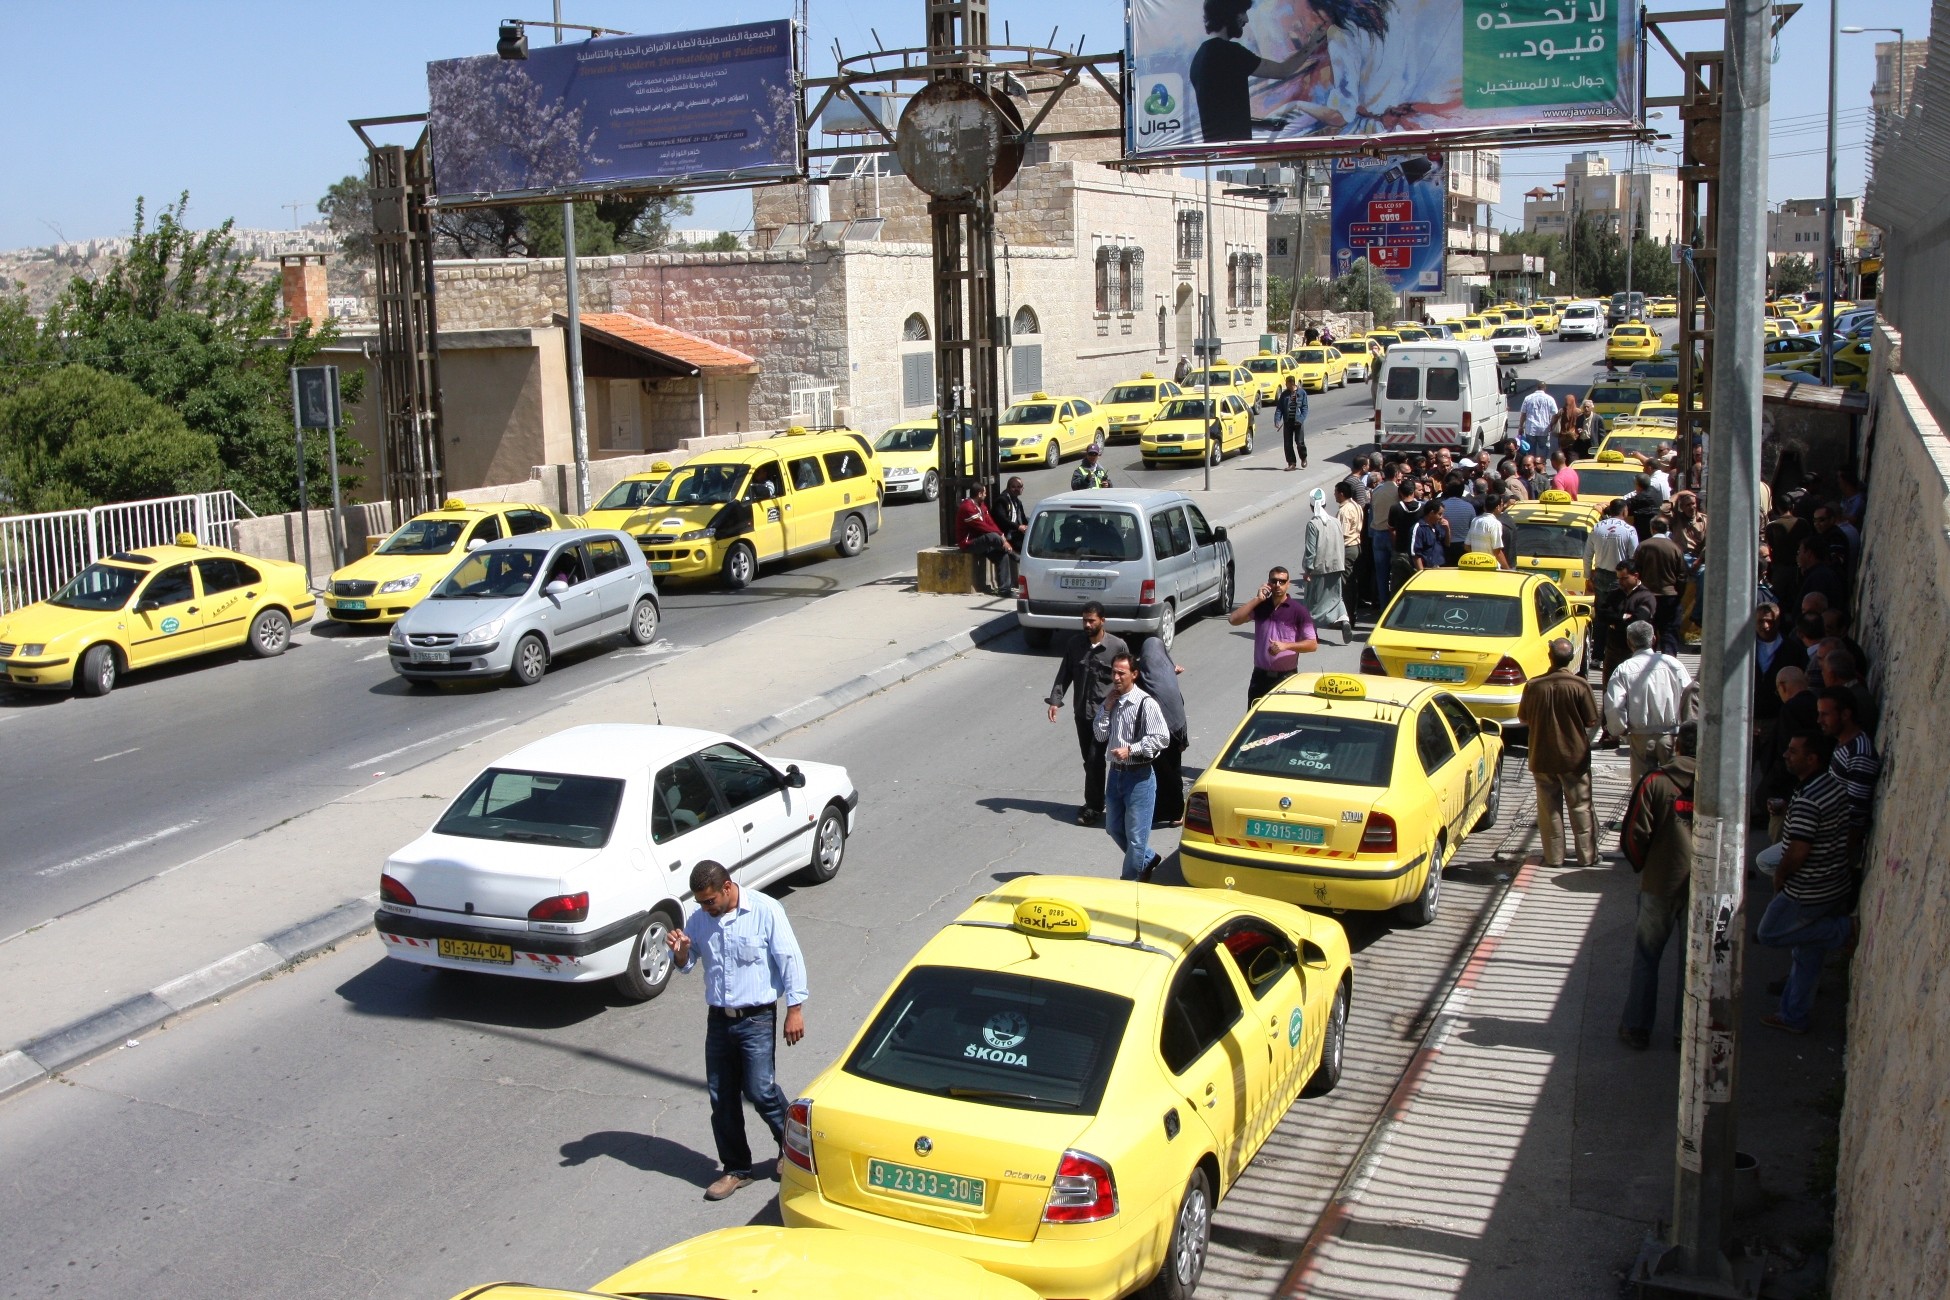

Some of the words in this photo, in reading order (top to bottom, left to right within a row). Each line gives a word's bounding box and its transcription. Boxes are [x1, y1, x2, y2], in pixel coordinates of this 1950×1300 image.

[1588, 0, 1605, 22] لا
[697, 32, 743, 48] الفلسطينية
[744, 28, 776, 42] الجمعية
[641, 42, 671, 55] الأمراض
[672, 38, 696, 51] لأطباء
[577, 49, 614, 63] والتناسلية
[614, 45, 641, 58] الجلدية
[622, 60, 656, 71] Modern
[659, 51, 719, 67] Dermatology
[722, 48, 732, 58] in
[735, 44, 777, 57] Palestine
[682, 72, 700, 81] سيادة
[700, 70, 714, 78] رعاية
[714, 68, 727, 76] تحت
[626, 80, 643, 88] عباس
[643, 77, 662, 85] محمود
[662, 74, 682, 84] الرئيس
[702, 80, 718, 89] رئيس
[1551, 77, 1560, 88] لا
[635, 87, 646, 95] الله
[664, 83, 688, 94] فلسطين
[1543, 105, 1619, 118] www.jawwal.ps
[1139, 119, 1180, 135] جوال
[1034, 905, 1042, 914] 16
[1049, 908, 1064, 917] 0285
[1020, 914, 1046, 929] taxi
[1046, 919, 1077, 930] تاكسي
[444, 941, 505, 959] 91-344-04
[989, 1037, 1013, 1046] AUTO
[964, 1043, 1028, 1067] ŠKODA
[1004, 1170, 1047, 1182] Octavia
